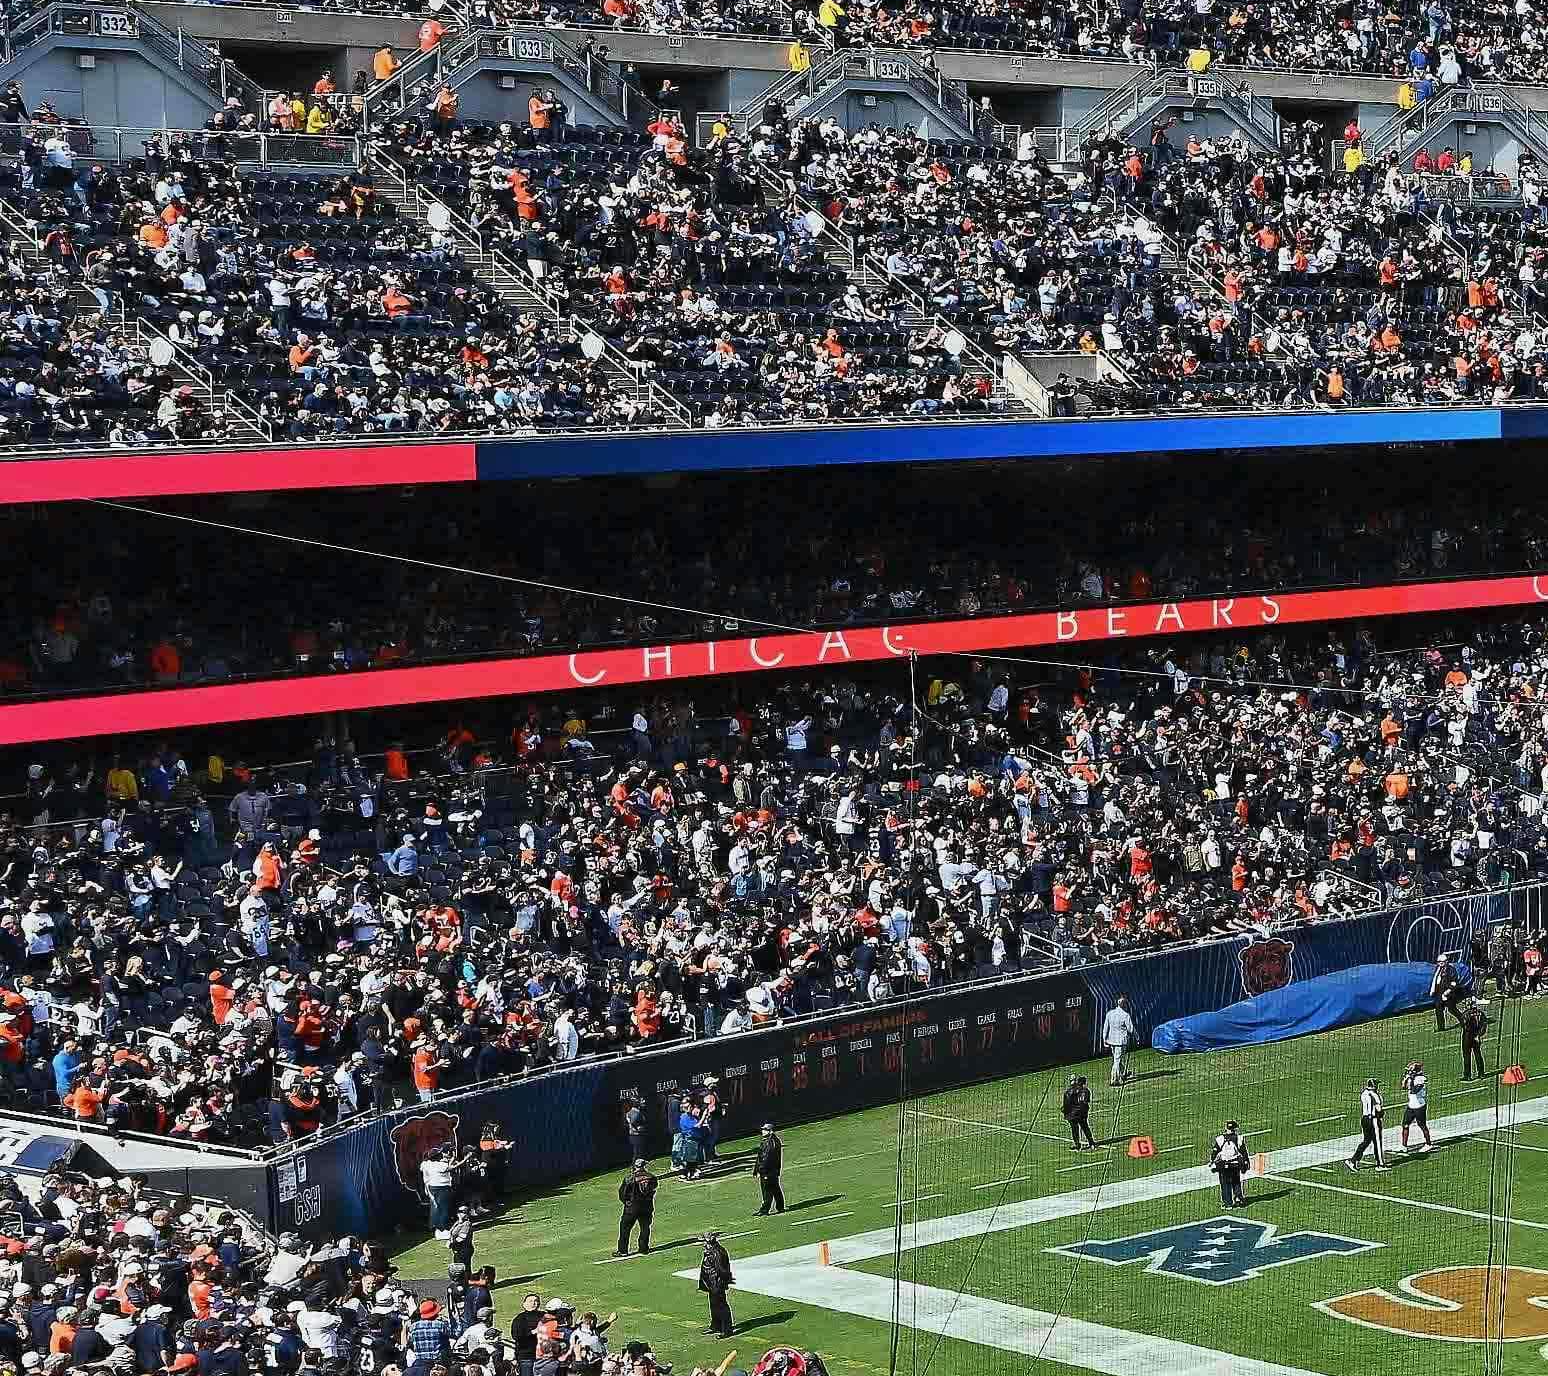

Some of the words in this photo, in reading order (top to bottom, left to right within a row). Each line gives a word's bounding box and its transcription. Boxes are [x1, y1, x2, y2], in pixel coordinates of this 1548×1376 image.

[1056, 596, 1279, 641] BEARS
[1137, 1140, 1150, 1155] G
[295, 1185, 321, 1226] GSH
